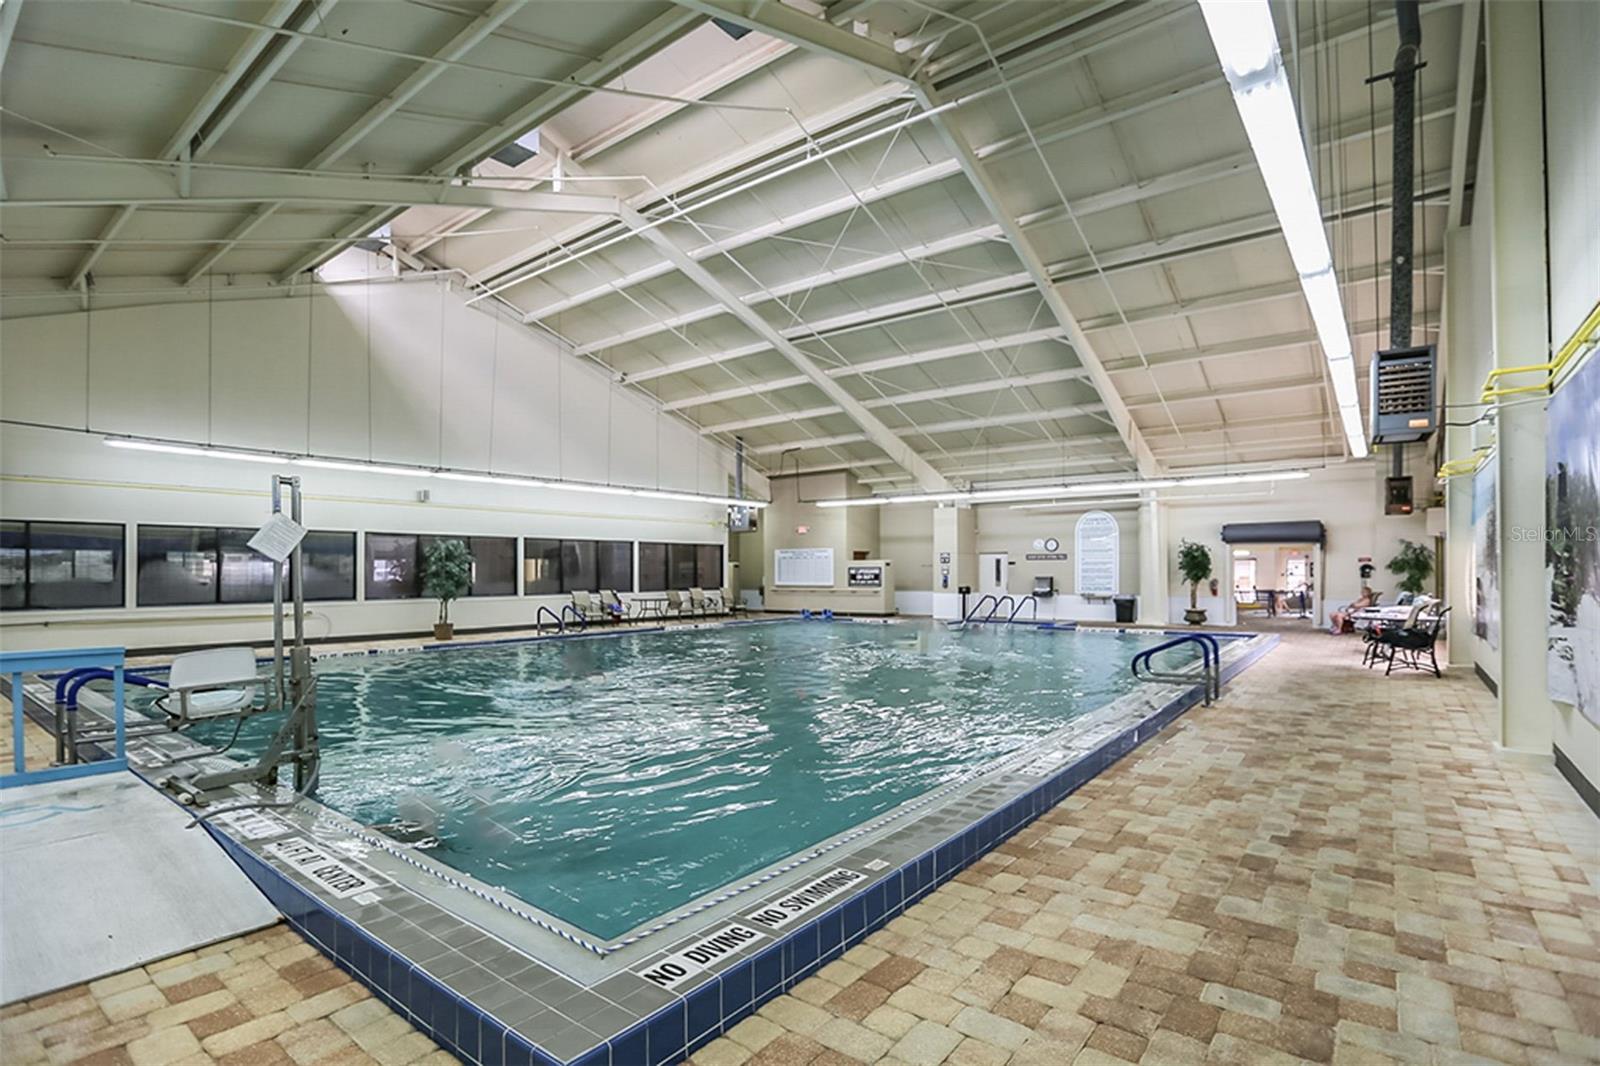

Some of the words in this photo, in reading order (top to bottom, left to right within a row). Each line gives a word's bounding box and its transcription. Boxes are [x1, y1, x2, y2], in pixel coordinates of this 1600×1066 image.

[312, 865, 366, 893] CENTER
[750, 908, 788, 927] NO
[779, 869, 861, 912] SWIMMING
[643, 963, 688, 986] NO
[683, 926, 757, 964] DIVING
